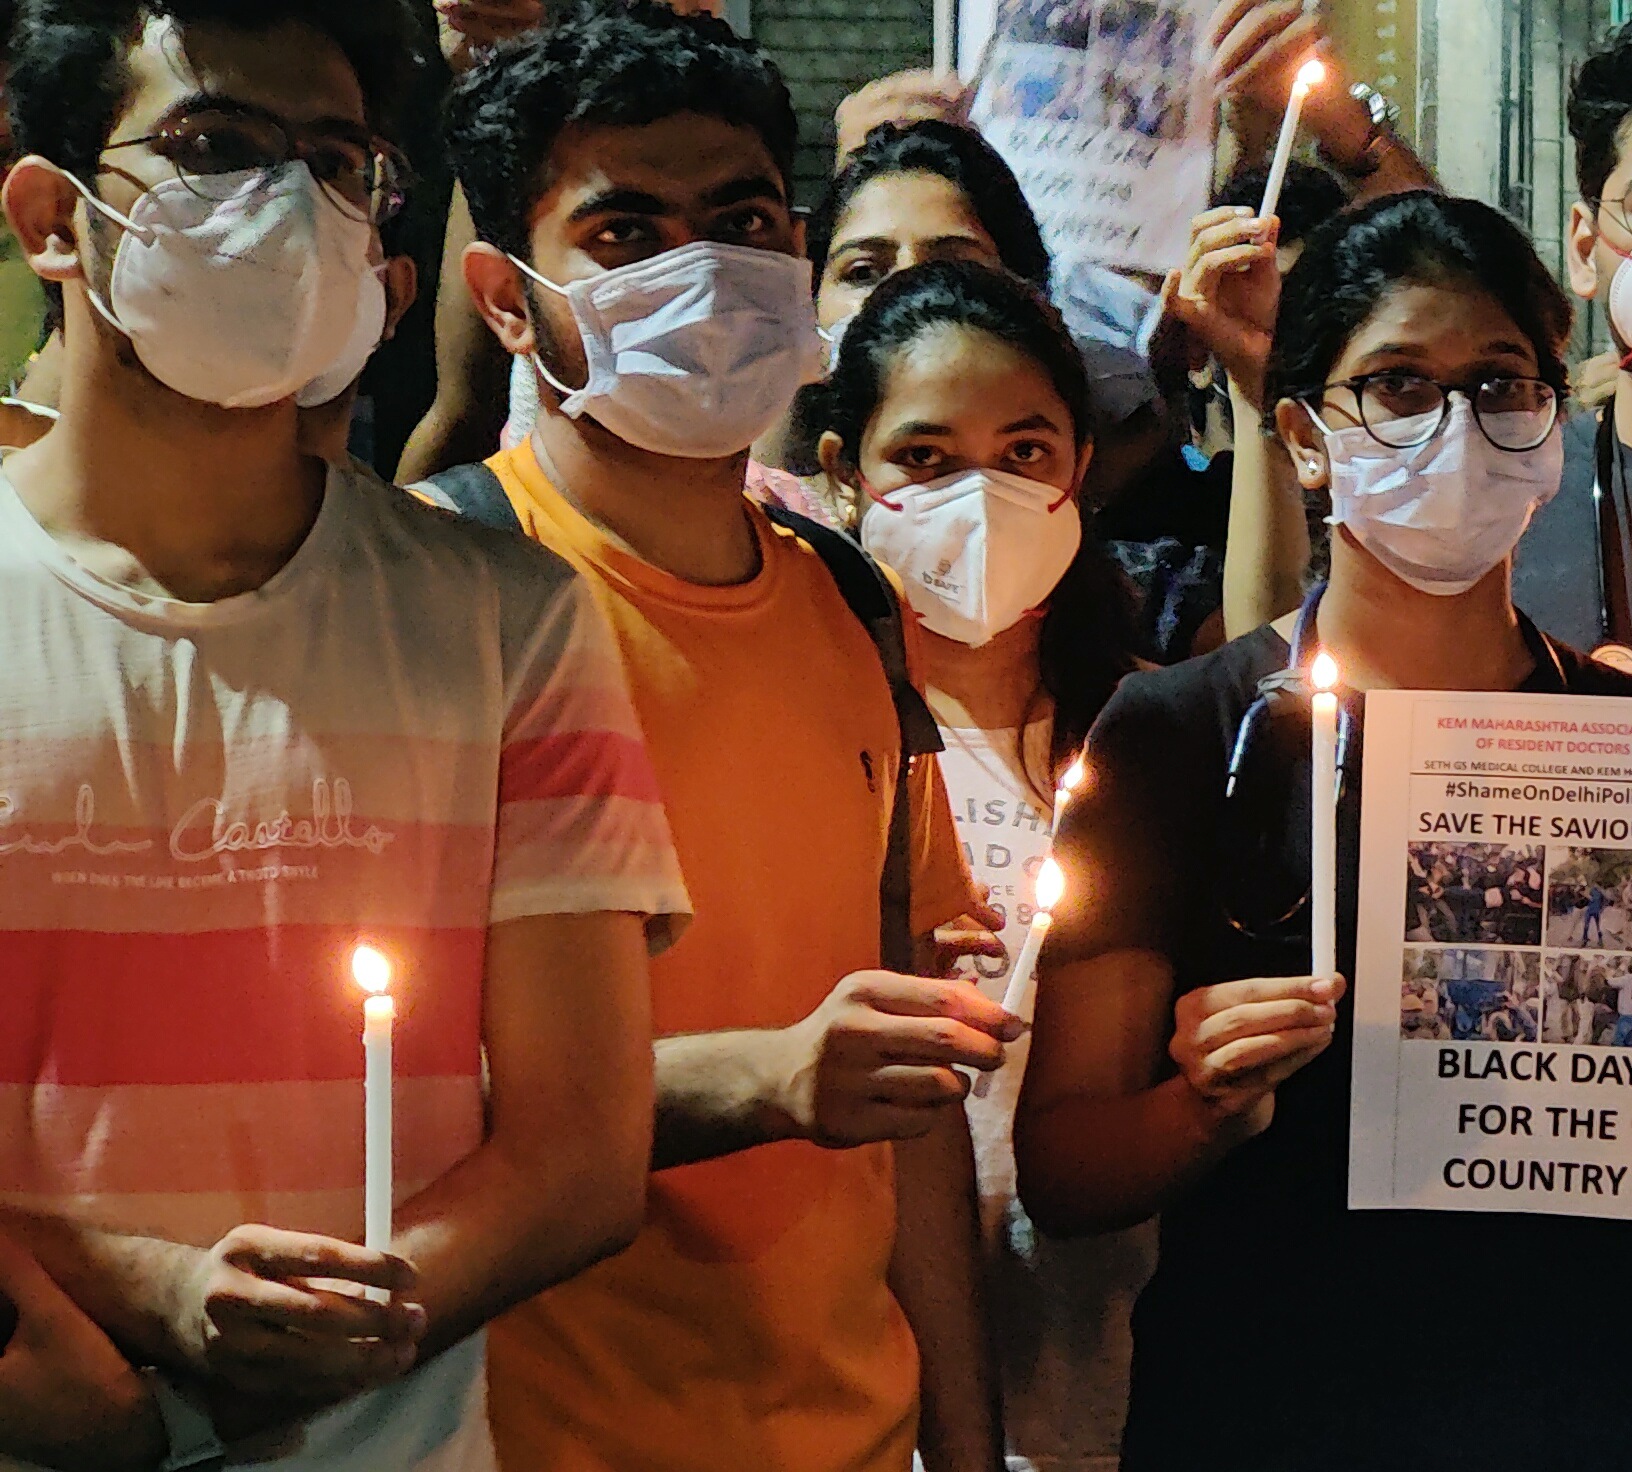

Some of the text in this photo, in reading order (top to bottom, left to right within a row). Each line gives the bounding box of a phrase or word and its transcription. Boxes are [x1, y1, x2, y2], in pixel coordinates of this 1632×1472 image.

[1437, 717, 1467, 730] KEM
[1471, 719, 1578, 733] MAHARASHTRA
[1476, 737, 1631, 755] OF RESIDENT DOCTORS
[1424, 760, 1451, 770] SETH
[1454, 761, 1467, 771] GS
[1471, 762, 1518, 773] MEDICAL
[1522, 764, 1567, 775] COLLEGE
[1570, 766, 1594, 776] AND
[1597, 767, 1621, 777] KEM
[955, 798, 1053, 836] ISH
[1419, 812, 1484, 834] SAVE
[1492, 814, 1542, 837] THE
[1438, 1049, 1558, 1082] BLACK
[1458, 1104, 1618, 1140] FOR THE
[1443, 1158, 1628, 1196] COUNTRY
